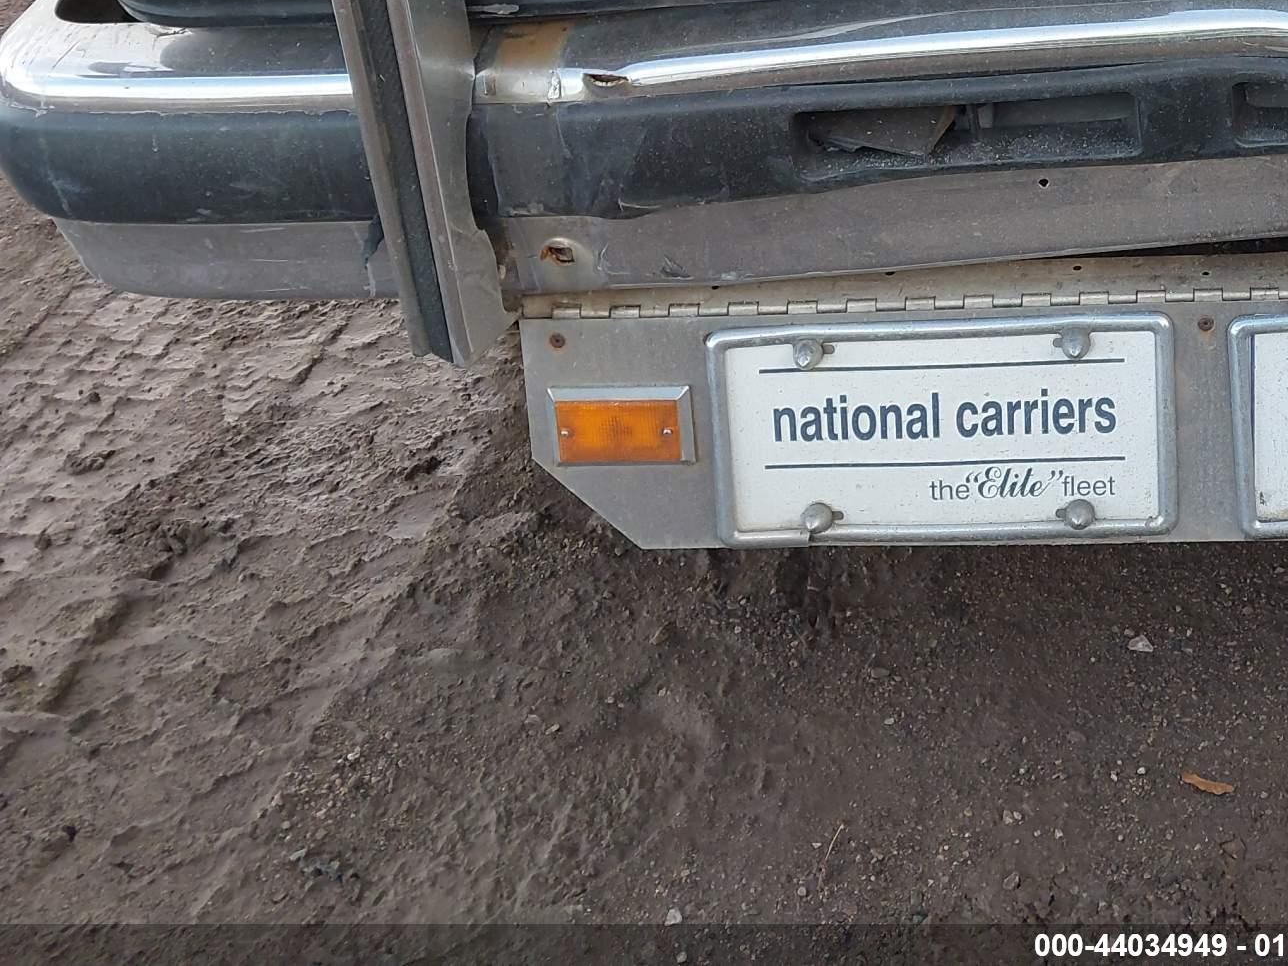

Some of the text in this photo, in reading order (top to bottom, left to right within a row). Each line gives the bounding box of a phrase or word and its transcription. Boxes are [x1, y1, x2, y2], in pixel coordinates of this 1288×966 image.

[773, 388, 1117, 442] national carriers
[930, 480, 970, 501] the
[1062, 475, 1115, 496] fleet
